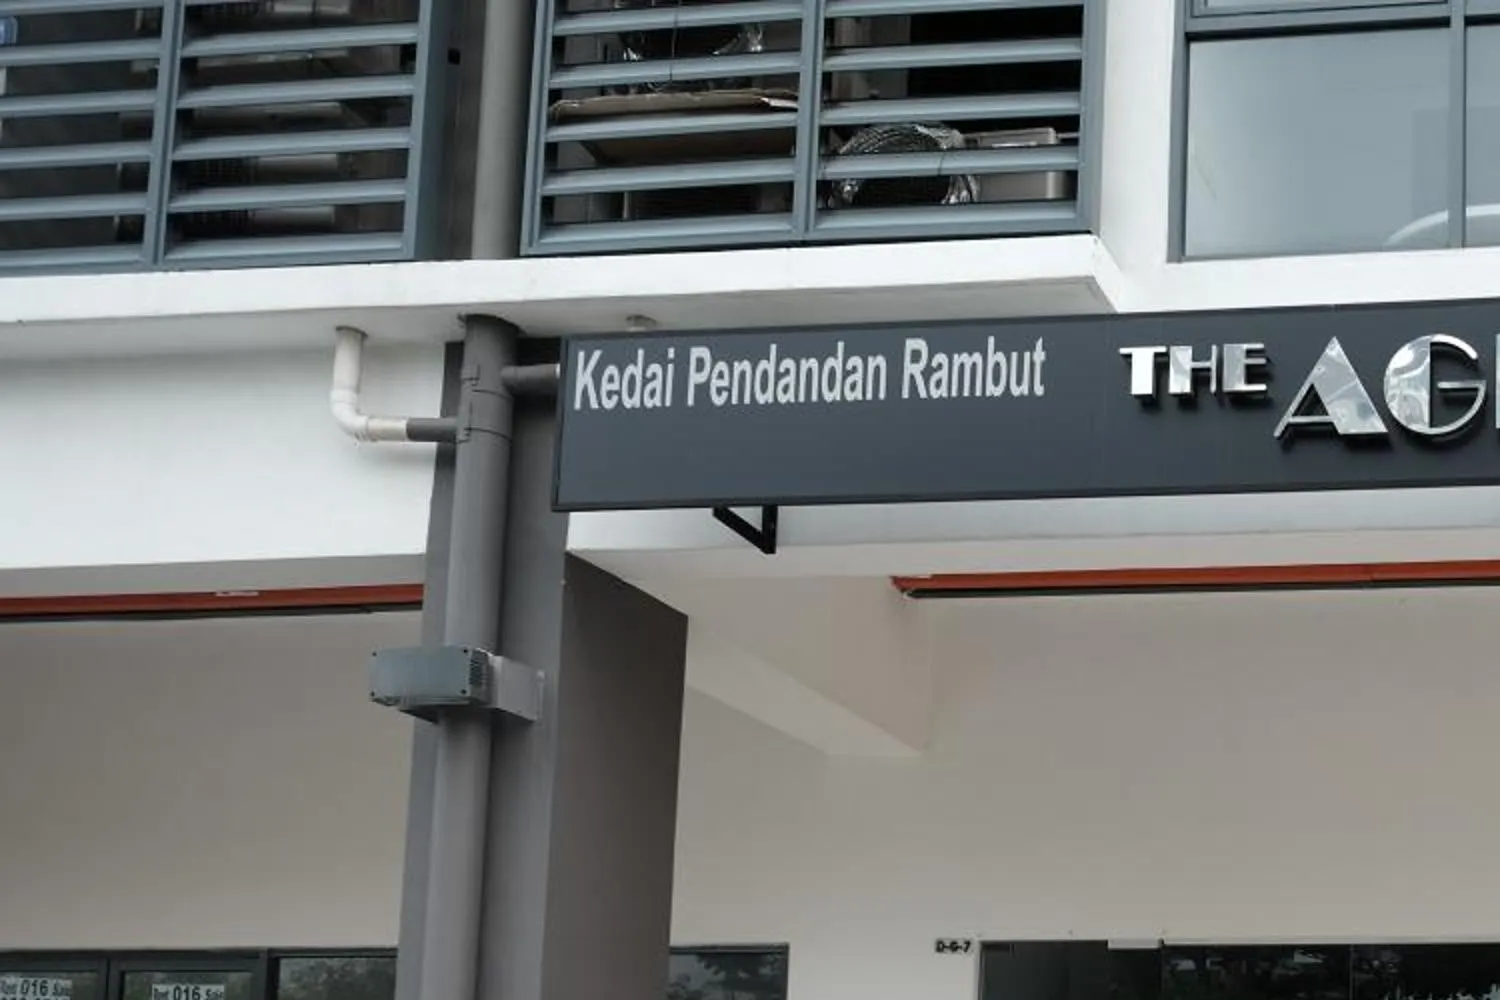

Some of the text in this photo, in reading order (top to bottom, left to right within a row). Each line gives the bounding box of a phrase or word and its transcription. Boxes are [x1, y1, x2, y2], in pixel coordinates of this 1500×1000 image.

[574, 336, 1045, 410] Kedai Pendandan Rambut
[1118, 342, 1271, 400] THE
